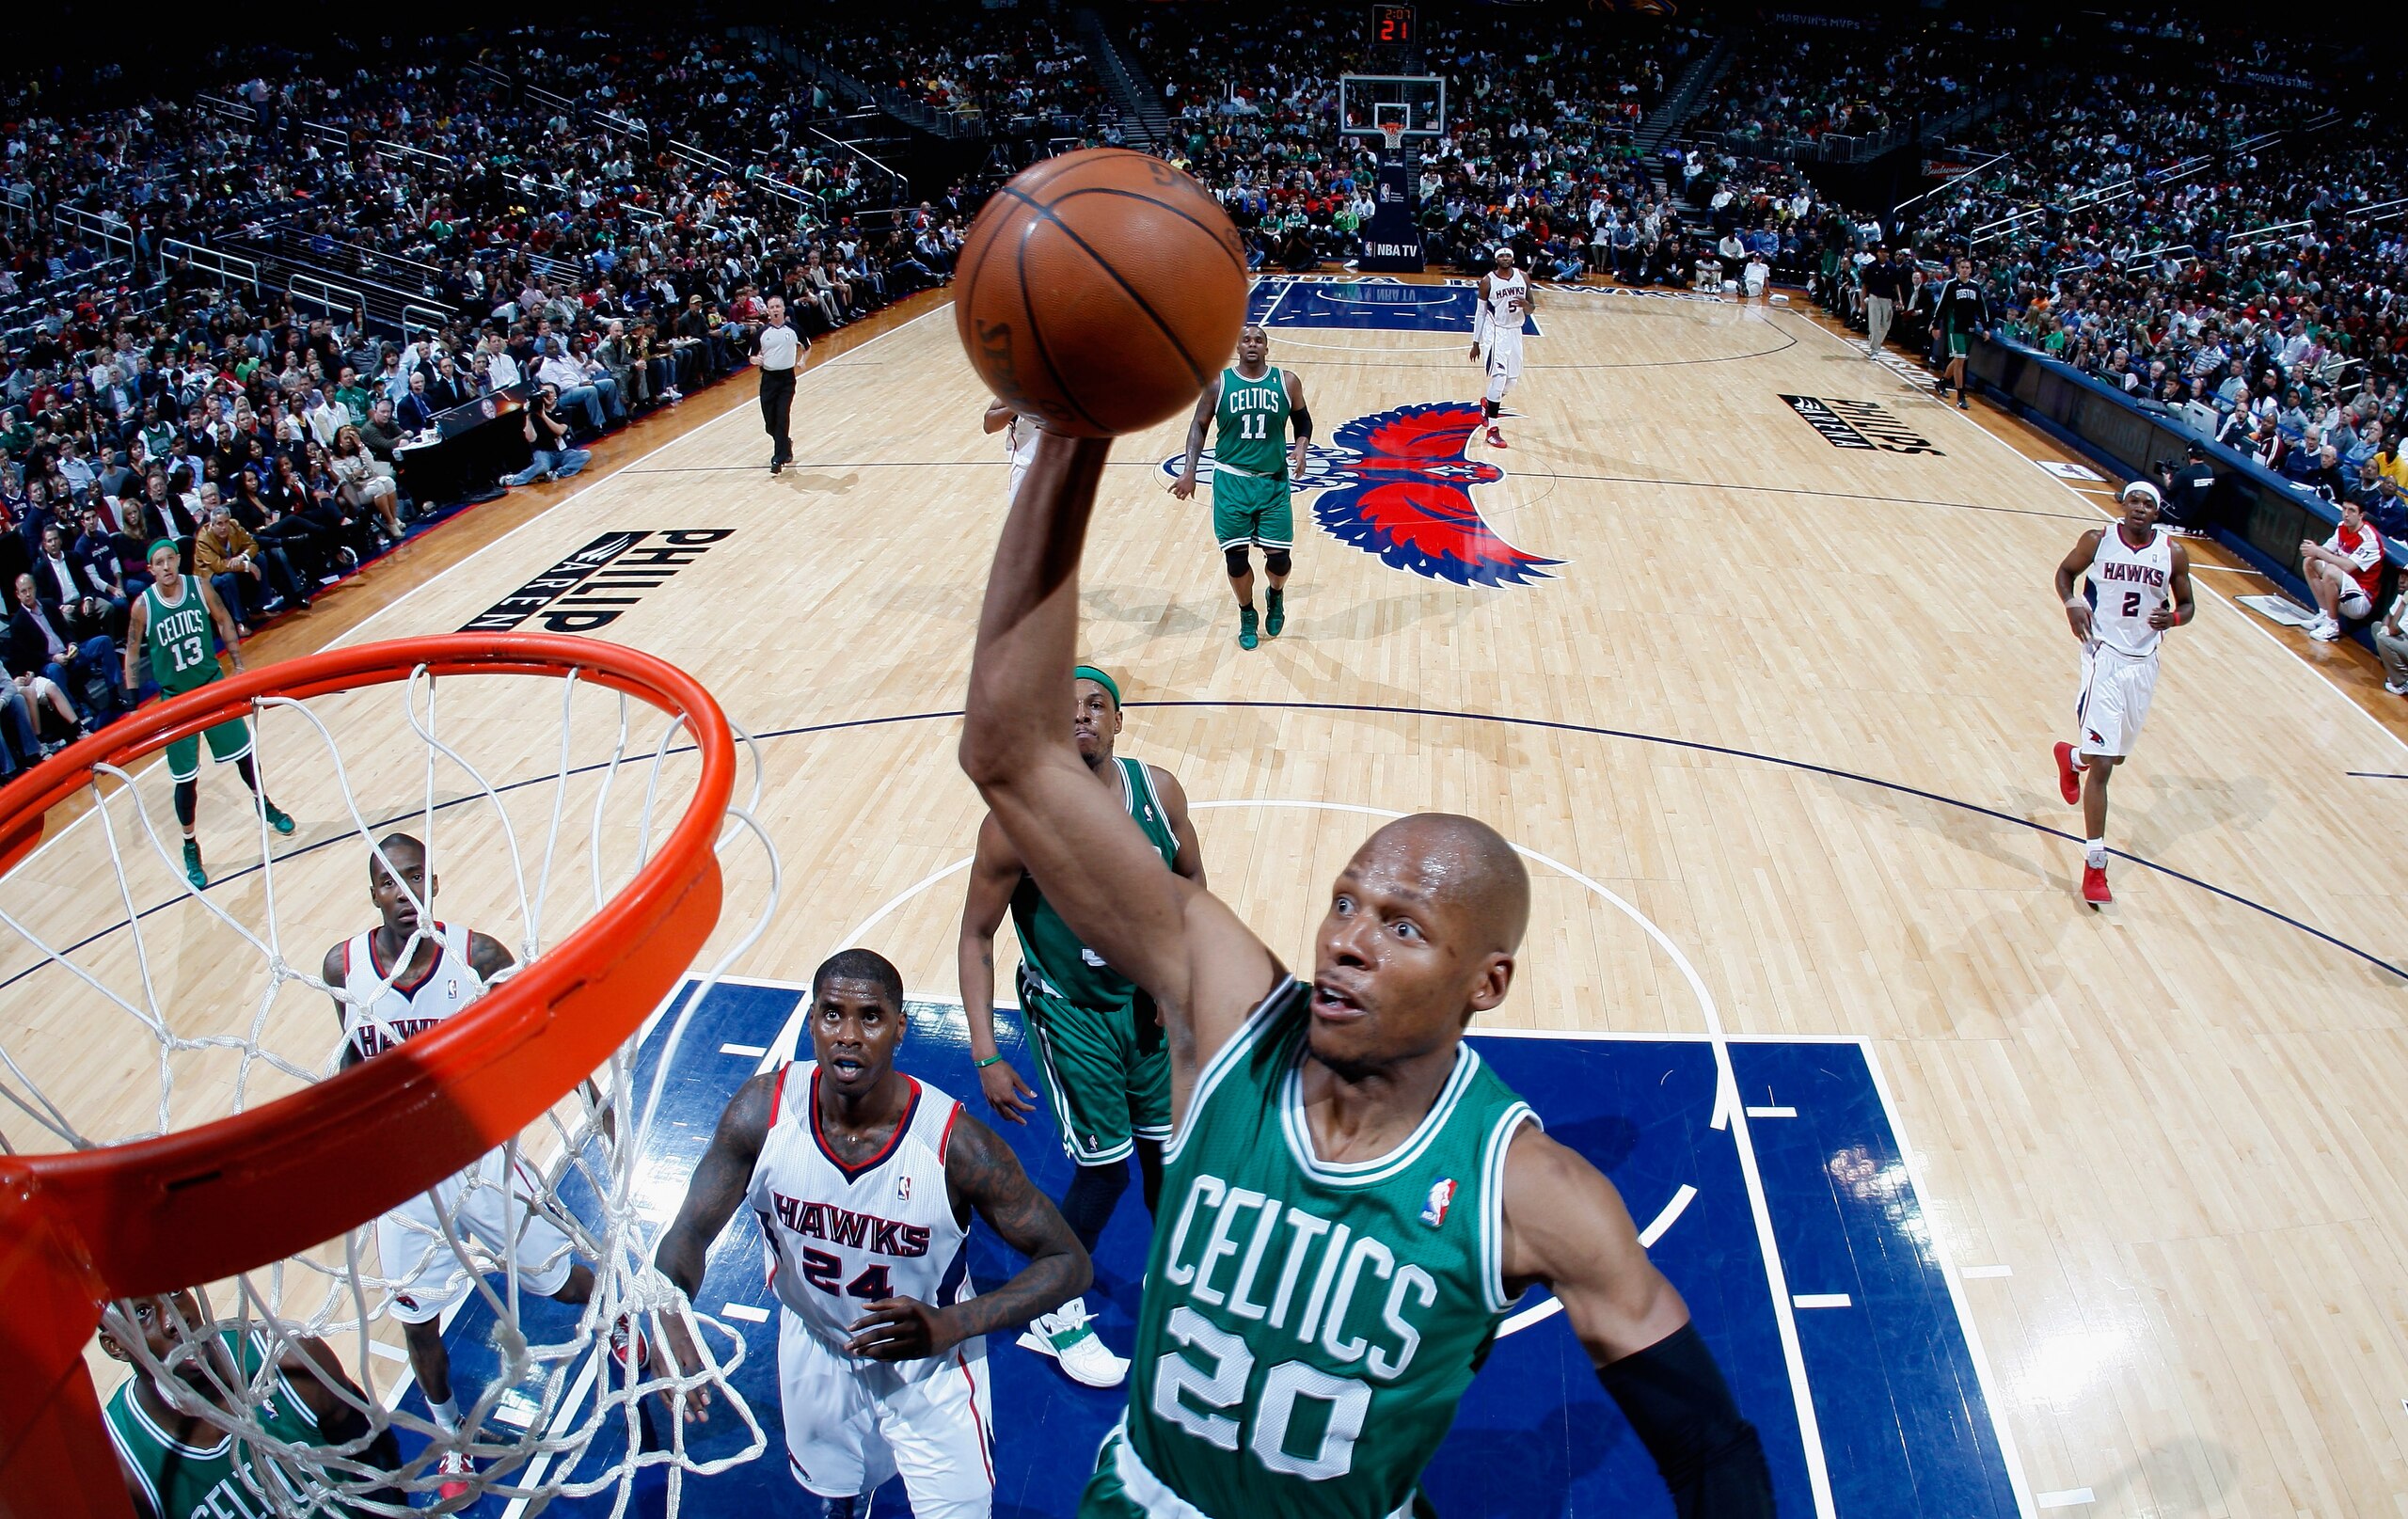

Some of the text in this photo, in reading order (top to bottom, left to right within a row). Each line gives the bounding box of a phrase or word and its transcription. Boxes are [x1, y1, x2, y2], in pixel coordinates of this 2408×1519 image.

[1386, 9, 1410, 19] 2:07
[1381, 21, 1406, 40] 21
[1922, 165, 1973, 176] Budweiser
[1377, 244, 1418, 257] NBA TV
[1496, 287, 1525, 299] HAWKS
[1956, 289, 1977, 300] BOSTON
[1508, 300, 1518, 313] 5
[1229, 388, 1278, 414] CELTICS
[1241, 414, 1266, 439] 11
[1794, 406, 1871, 447] ARENA
[1821, 398, 1947, 456] PHILIPS
[536, 528, 737, 633] PHILIP
[2103, 562, 2163, 588] HAWKS
[467, 562, 600, 628] AREN
[2122, 592, 2141, 617] 2
[156, 609, 204, 647] CELTICS
[171, 636, 204, 672] 13
[773, 1191, 930, 1258] HAWKS
[802, 1245, 895, 1304] 24
[1165, 1174, 1438, 1380] CELTICS
[1153, 1305, 1372, 1481] 20
